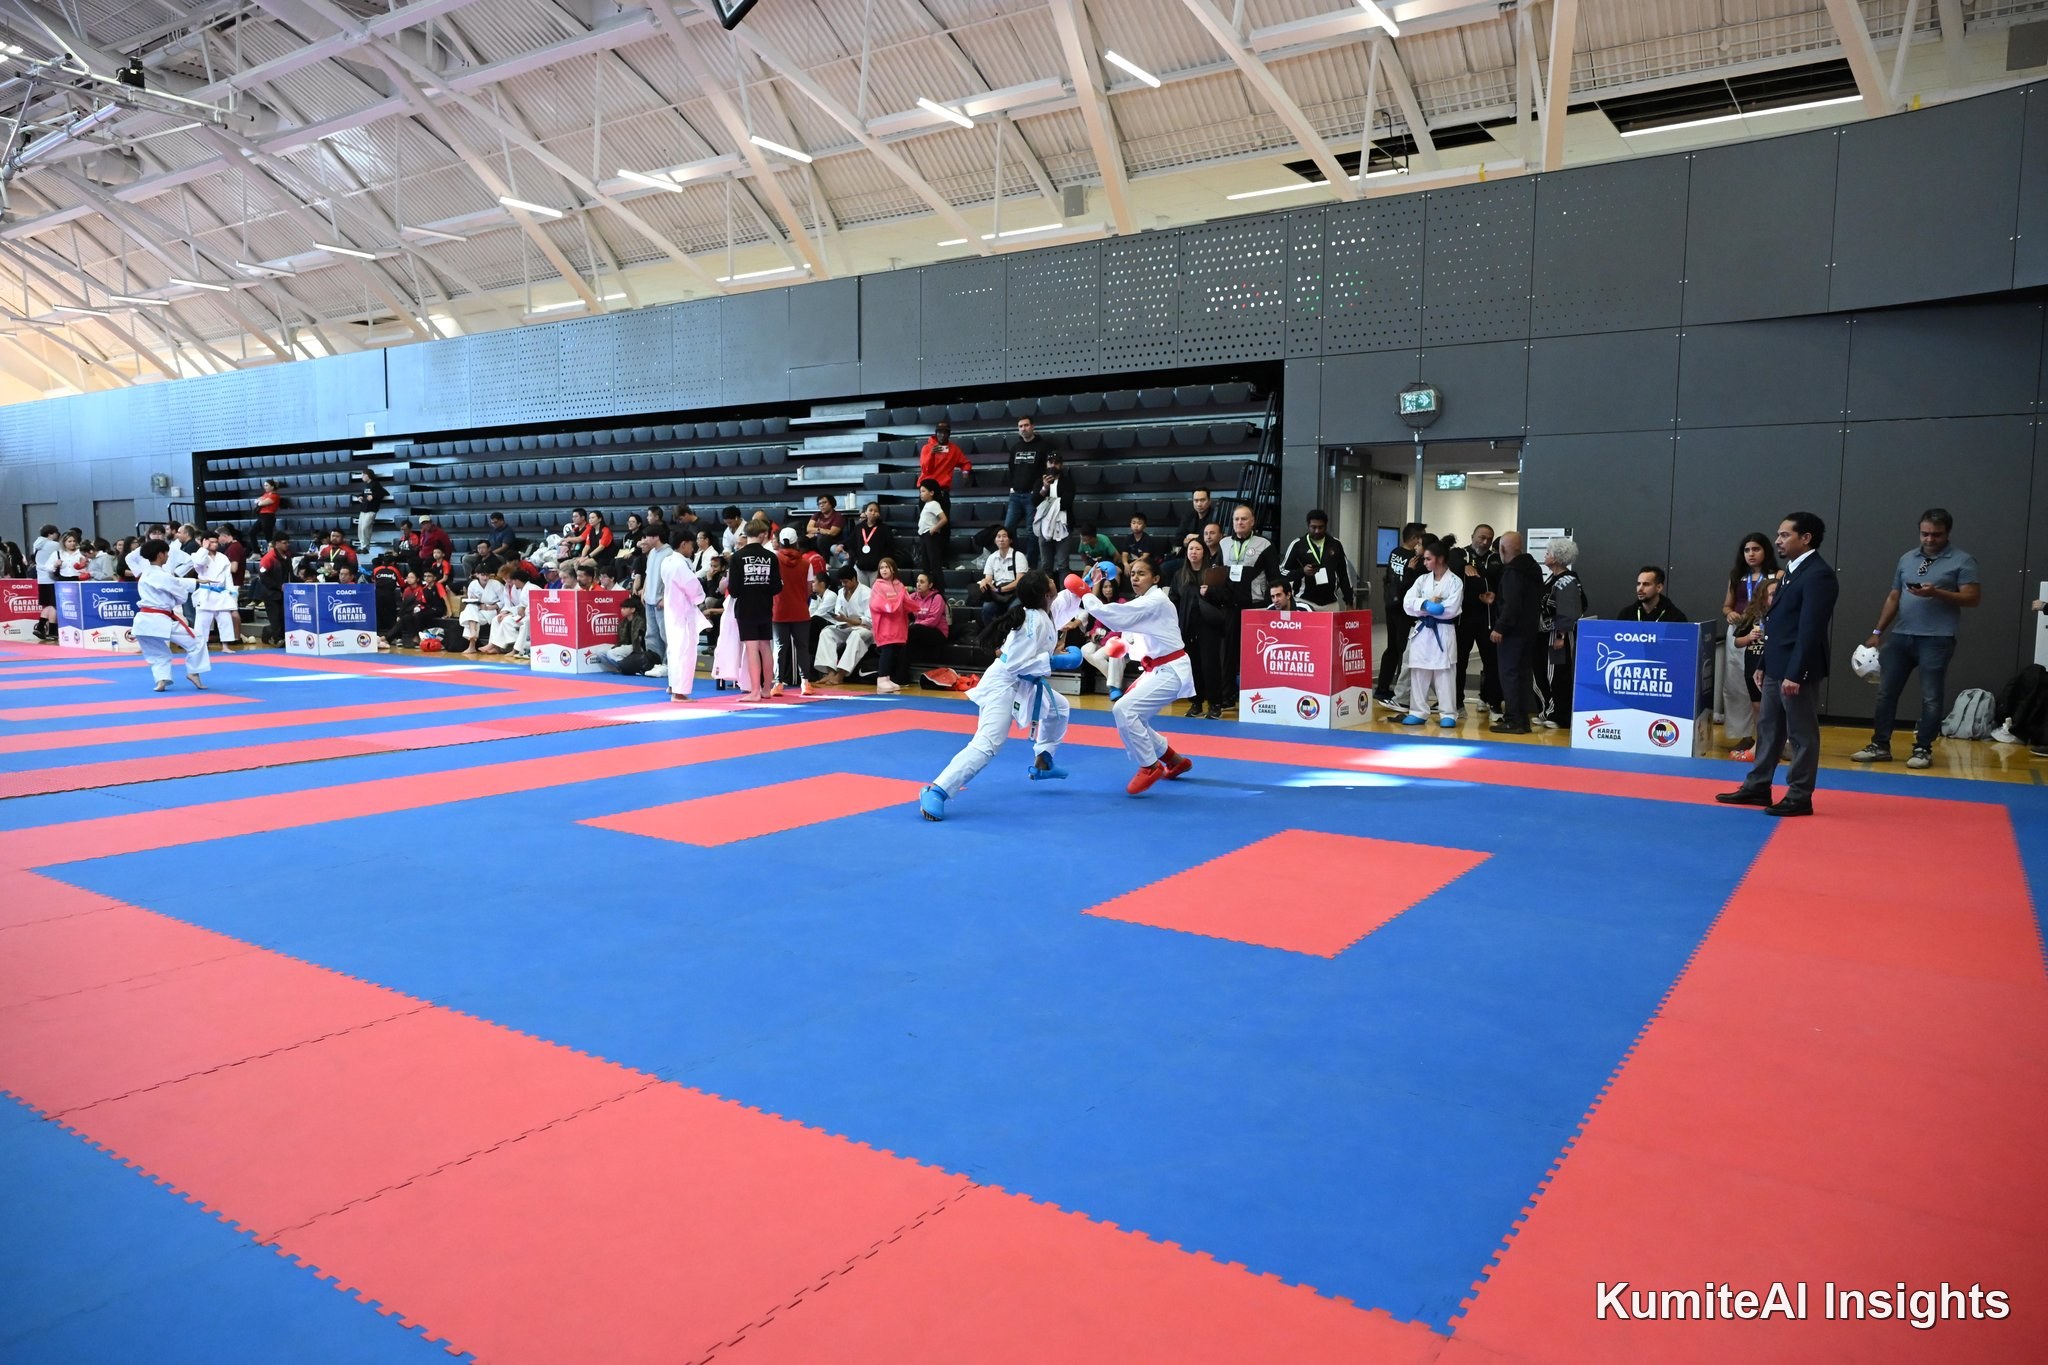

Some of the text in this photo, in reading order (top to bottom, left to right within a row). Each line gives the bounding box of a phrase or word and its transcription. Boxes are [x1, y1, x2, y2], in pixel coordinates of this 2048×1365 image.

[742, 556, 771, 564] TEAM
[294, 607, 310, 615] KARATE
[337, 613, 367, 621] ONTARIO
[544, 617, 566, 626] KARATE
[595, 617, 619, 625] KARATE
[595, 625, 618, 633] ONTARI
[1269, 620, 1302, 630] COACH
[1344, 620, 1360, 629] COACH
[544, 625, 569, 634] ONTARIO
[1614, 632, 1657, 643] COACH
[1269, 649, 1310, 662] KARATE
[1345, 648, 1364, 660] KARATE
[1269, 660, 1315, 673] ONTARIO
[1344, 659, 1366, 672] ONTARIO
[1613, 665, 1668, 680] KARATE
[1613, 678, 1673, 694] ONTARIO
[1597, 727, 1621, 735] KARATE
